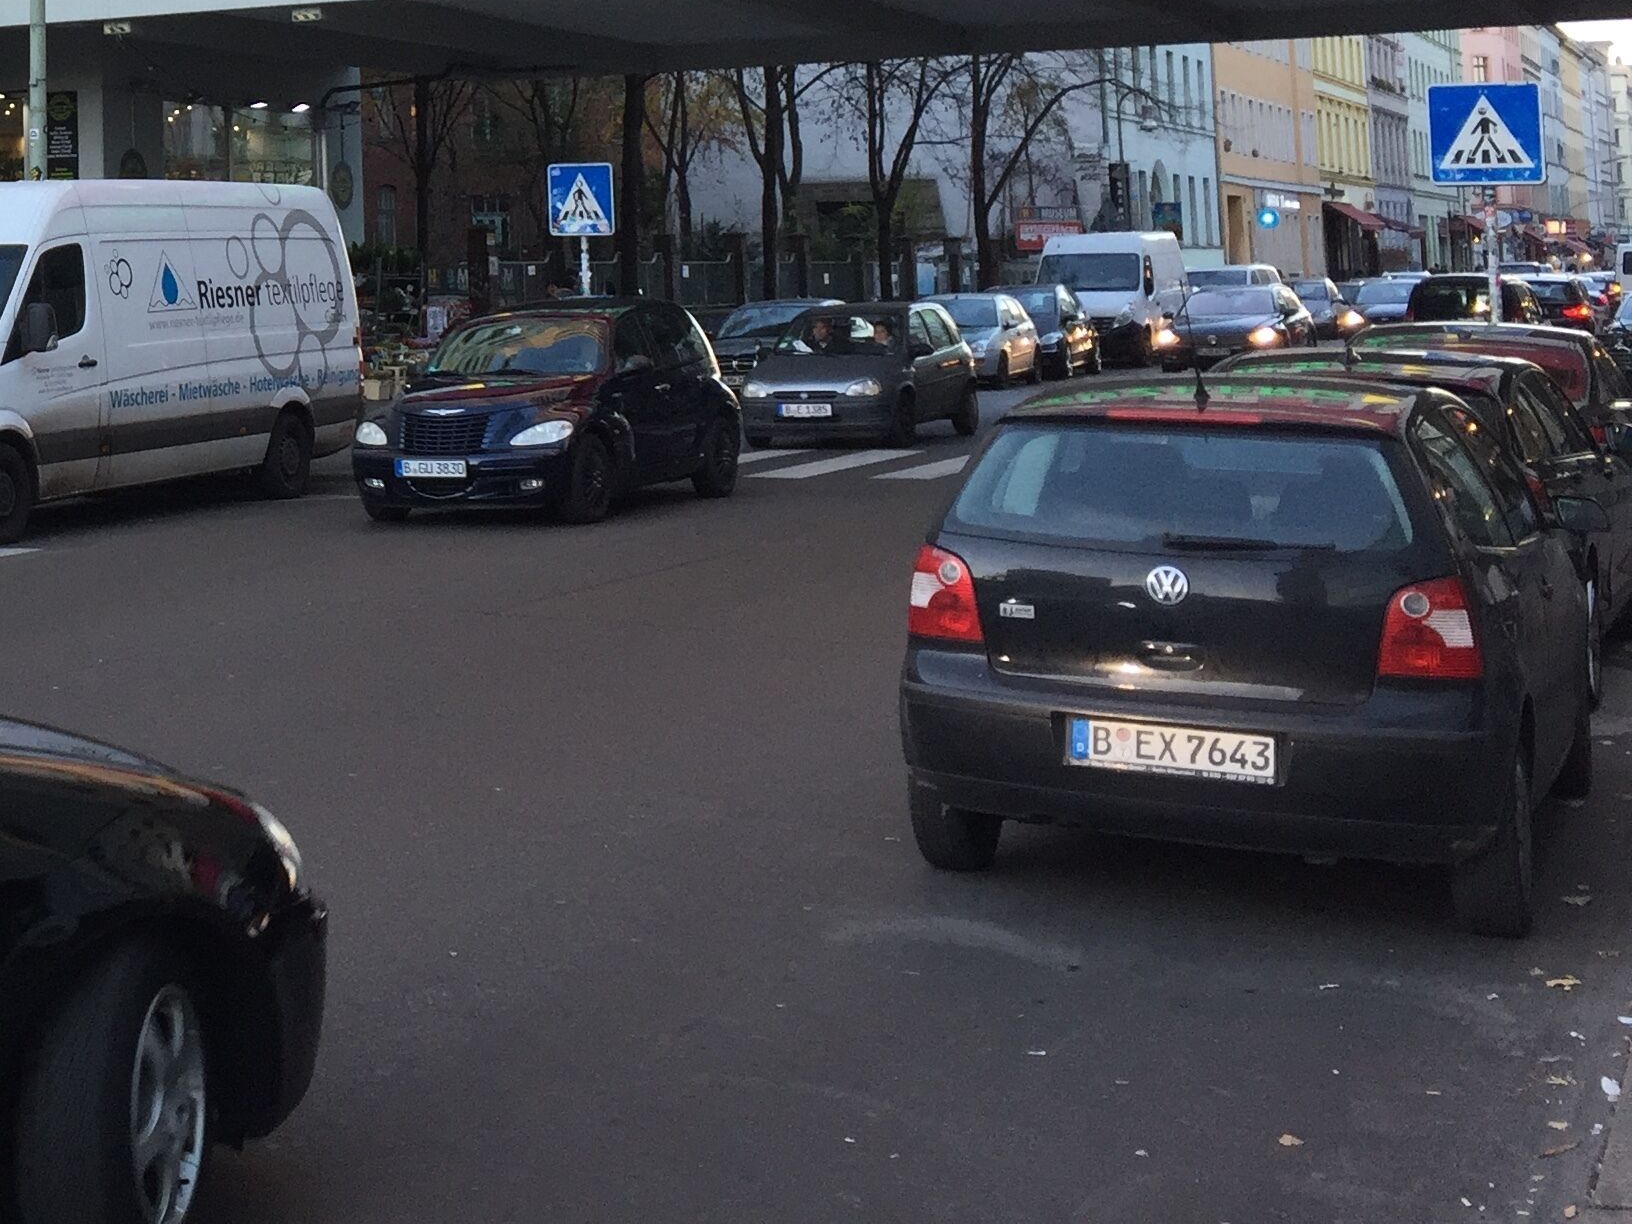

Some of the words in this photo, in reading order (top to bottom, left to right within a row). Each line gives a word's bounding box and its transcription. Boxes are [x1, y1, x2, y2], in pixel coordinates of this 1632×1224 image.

[197, 279, 262, 310] Riesner
[266, 273, 344, 311] textilpflege
[110, 386, 169, 409] Wäscherei
[178, 378, 241, 402] Mietwäsche
[317, 368, 360, 387] Reinigung
[1135, 729, 1178, 764] EX
[1186, 733, 1272, 772] 7643
